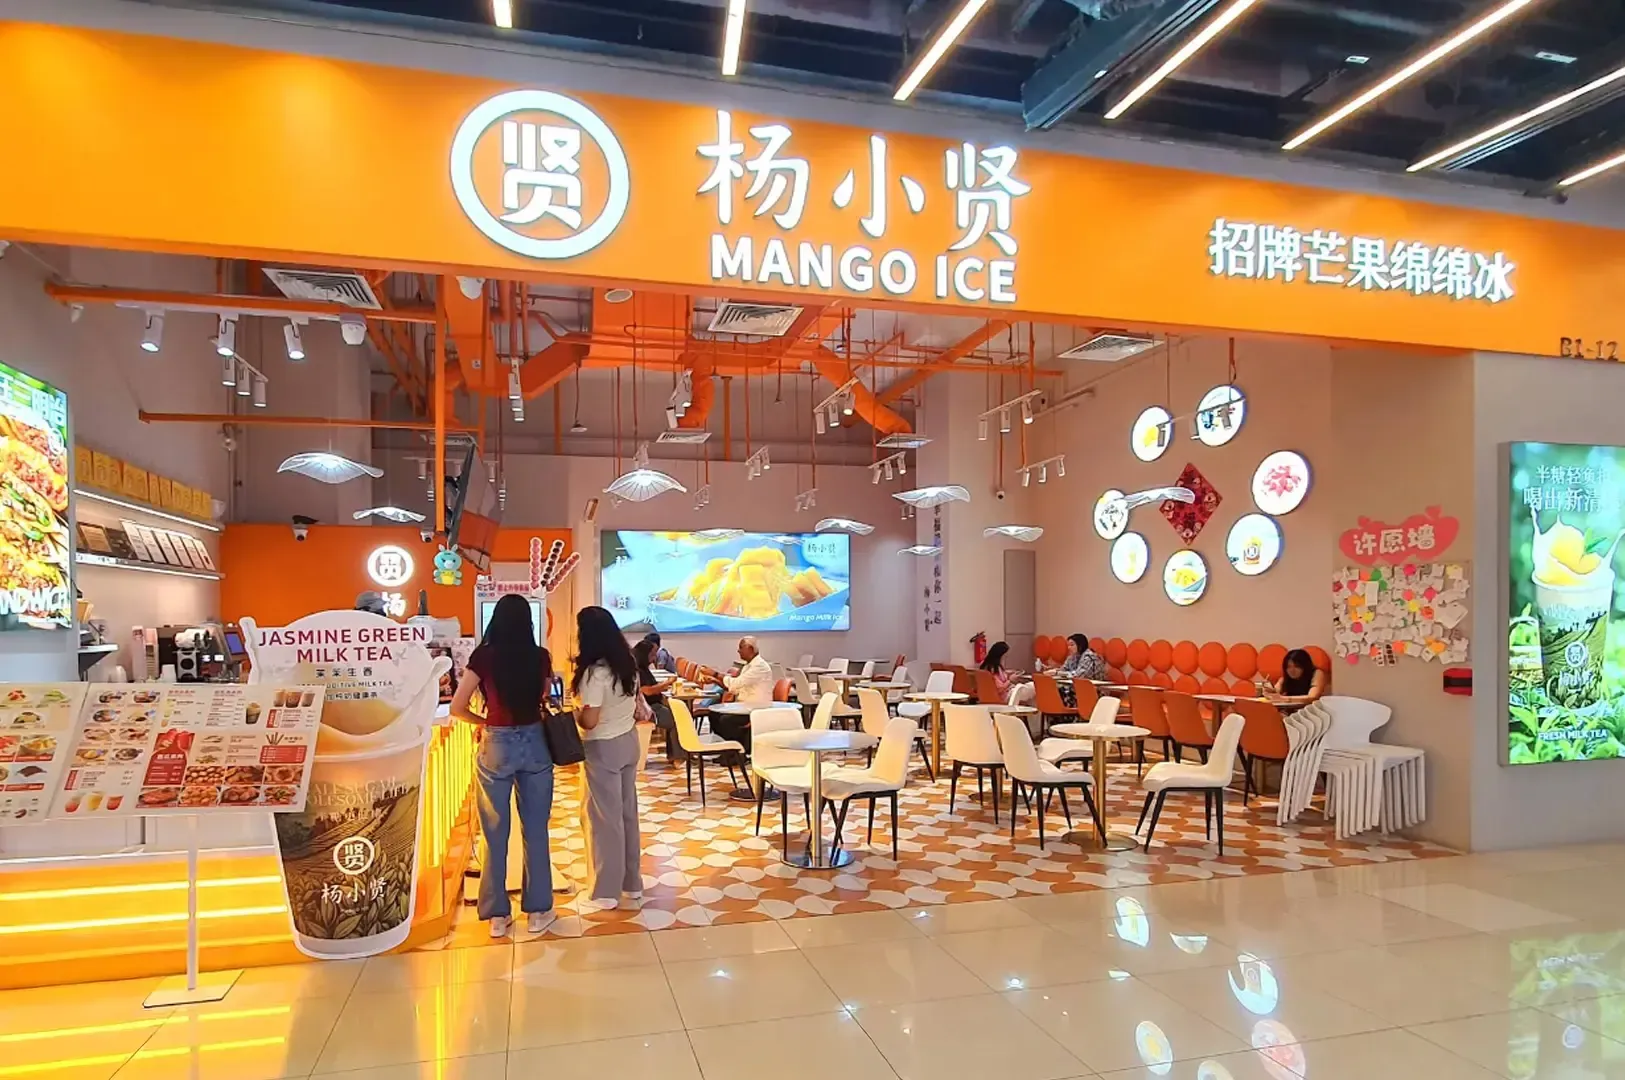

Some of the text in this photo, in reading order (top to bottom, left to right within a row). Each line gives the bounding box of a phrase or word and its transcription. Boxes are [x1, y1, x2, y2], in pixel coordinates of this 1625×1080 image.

[500, 120, 582, 230] 贤
[696, 109, 1032, 256] 杨小贤
[710, 233, 1018, 303] MANGO ICE
[1208, 217, 1516, 303] 招牌芒果绵绵冰
[1560, 336, 1619, 362] B1-12
[1353, 524, 1435, 555] 许愿墙
[259, 627, 426, 646] JASMINE GREEN
[297, 646, 393, 664] MILK TEA
[1538, 730, 1608, 742] FRESH MILK TEA
[321, 876, 387, 904] 杨小贤
